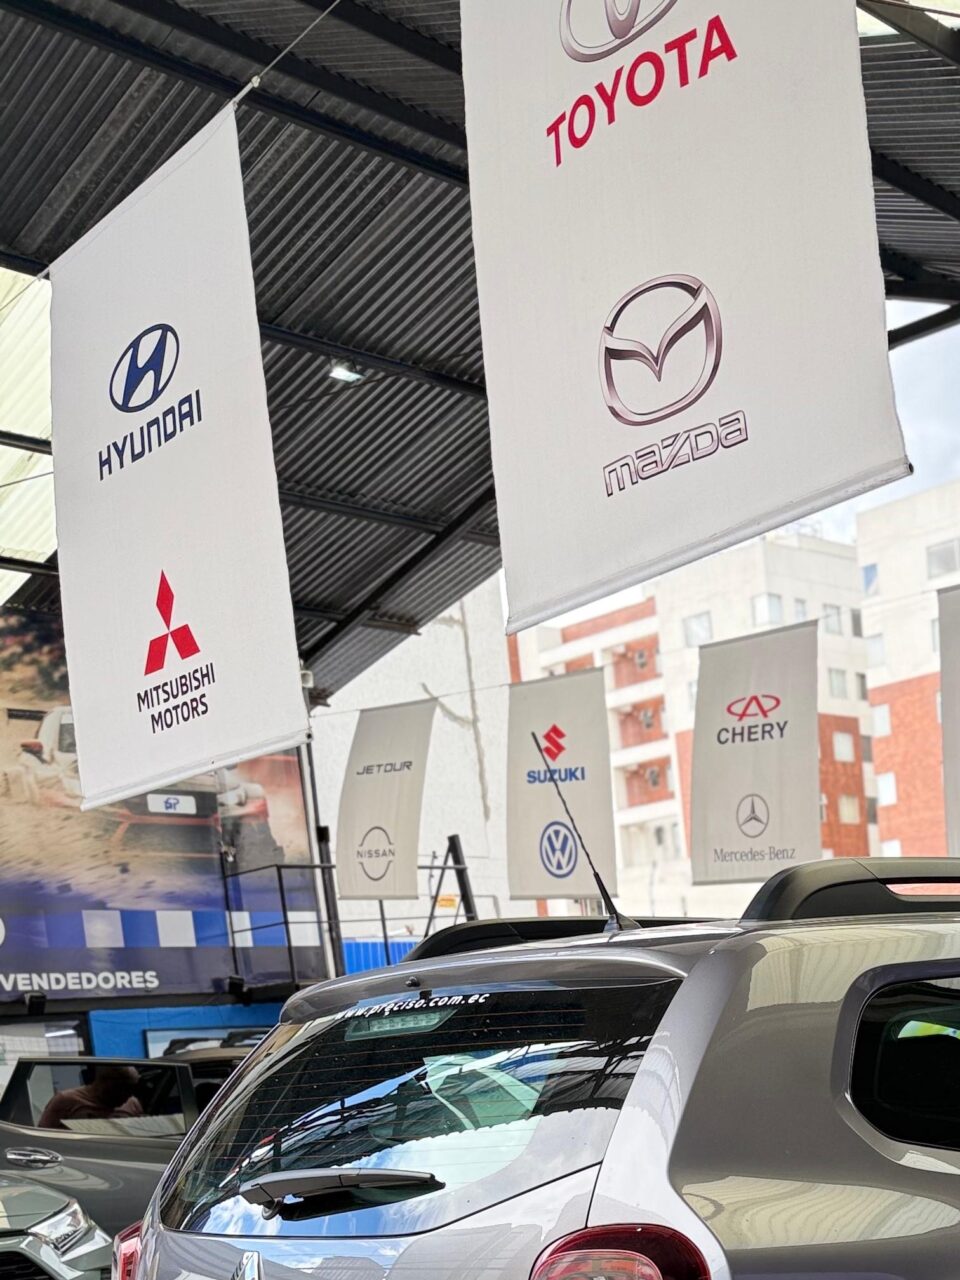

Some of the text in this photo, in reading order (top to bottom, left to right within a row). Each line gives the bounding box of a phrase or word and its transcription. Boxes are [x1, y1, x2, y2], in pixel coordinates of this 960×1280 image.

[546, 15, 738, 167] TOYOTA
[99, 389, 202, 481] HYUNDAI
[137, 662, 216, 712] MITSUBISHI
[151, 693, 209, 734] MOTORS
[716, 720, 788, 745] CHERY
[356, 761, 413, 775] JETOUR
[526, 766, 585, 784] SUZUKI
[356, 848, 396, 859] NISSAN
[713, 847, 796, 863] Mercedes-Benz
[0, 971, 160, 991] VENDEDORES
[334, 993, 490, 1020] www.preciso.com.ec
